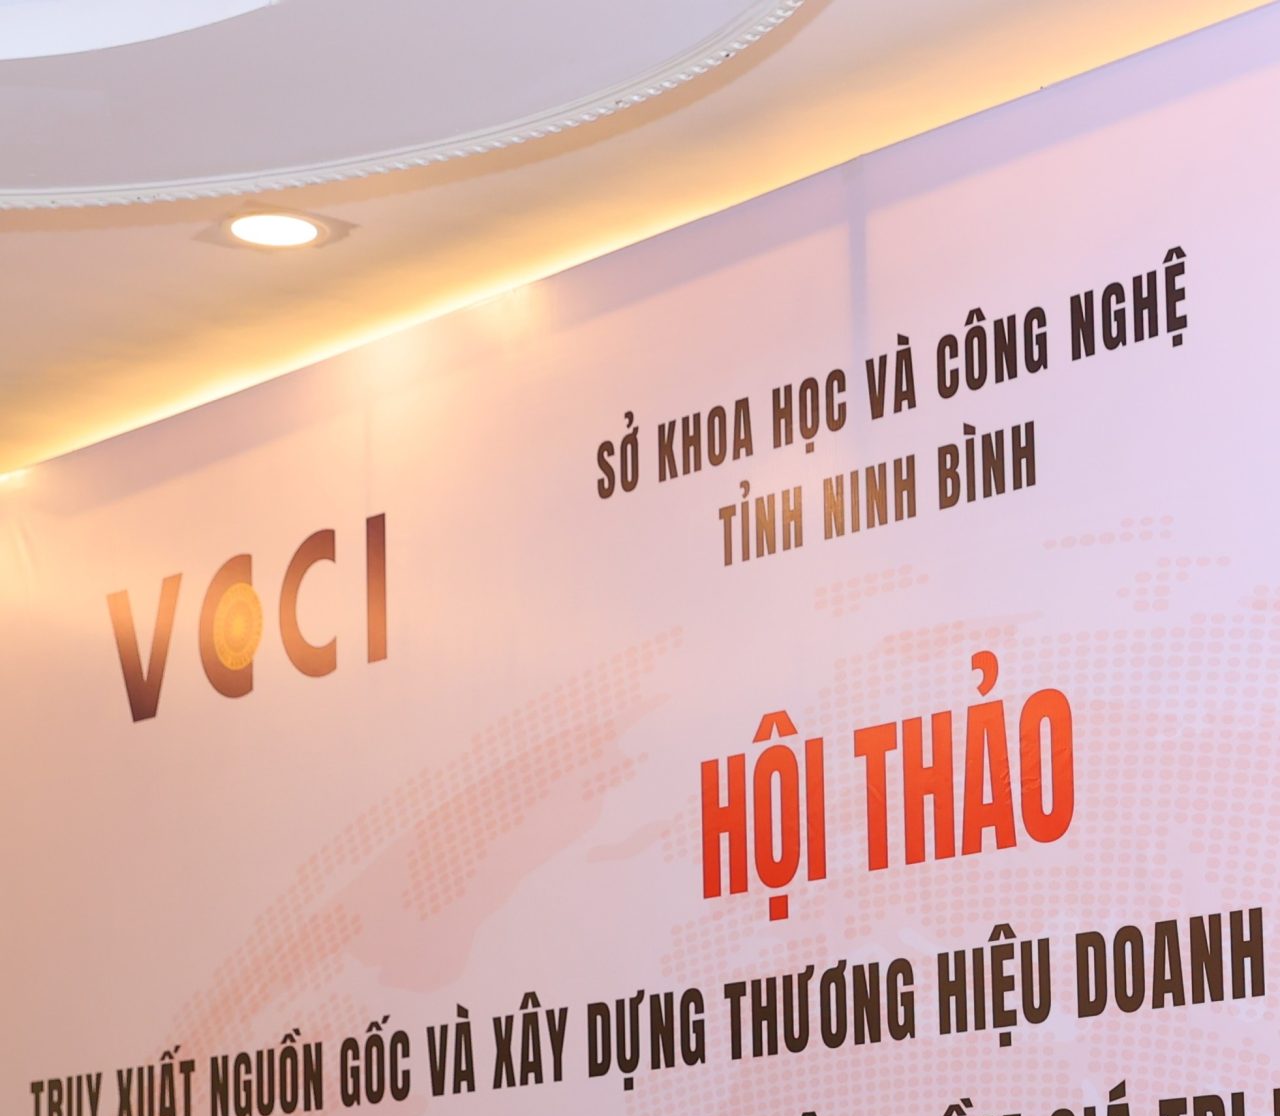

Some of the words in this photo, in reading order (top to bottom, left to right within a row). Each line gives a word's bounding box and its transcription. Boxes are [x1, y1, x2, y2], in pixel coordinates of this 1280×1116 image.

[597, 410, 639, 499] SỞ
[658, 397, 753, 484] KHOA
[772, 369, 847, 454] HỌC
[865, 333, 916, 420] VÀ
[936, 306, 1048, 399] CÔNG
[1070, 246, 1188, 361] NGHỆ
[719, 486, 803, 567] TỈNH
[823, 454, 916, 540] NINH
[938, 420, 1036, 511] BÌNH
[106, 513, 389, 724] VCCI
[701, 710, 826, 921] HỘI
[854, 650, 1074, 871] THẢO
[340, 1014, 411, 1108] GỐC
[426, 1003, 476, 1097] VÀ
[492, 991, 568, 1090] XÂY
[587, 988, 706, 1091] DỰNG
[724, 958, 915, 1060] THƯƠNG
[937, 923, 1051, 1048] HIỆU
[1075, 907, 1265, 1018] DOANH
